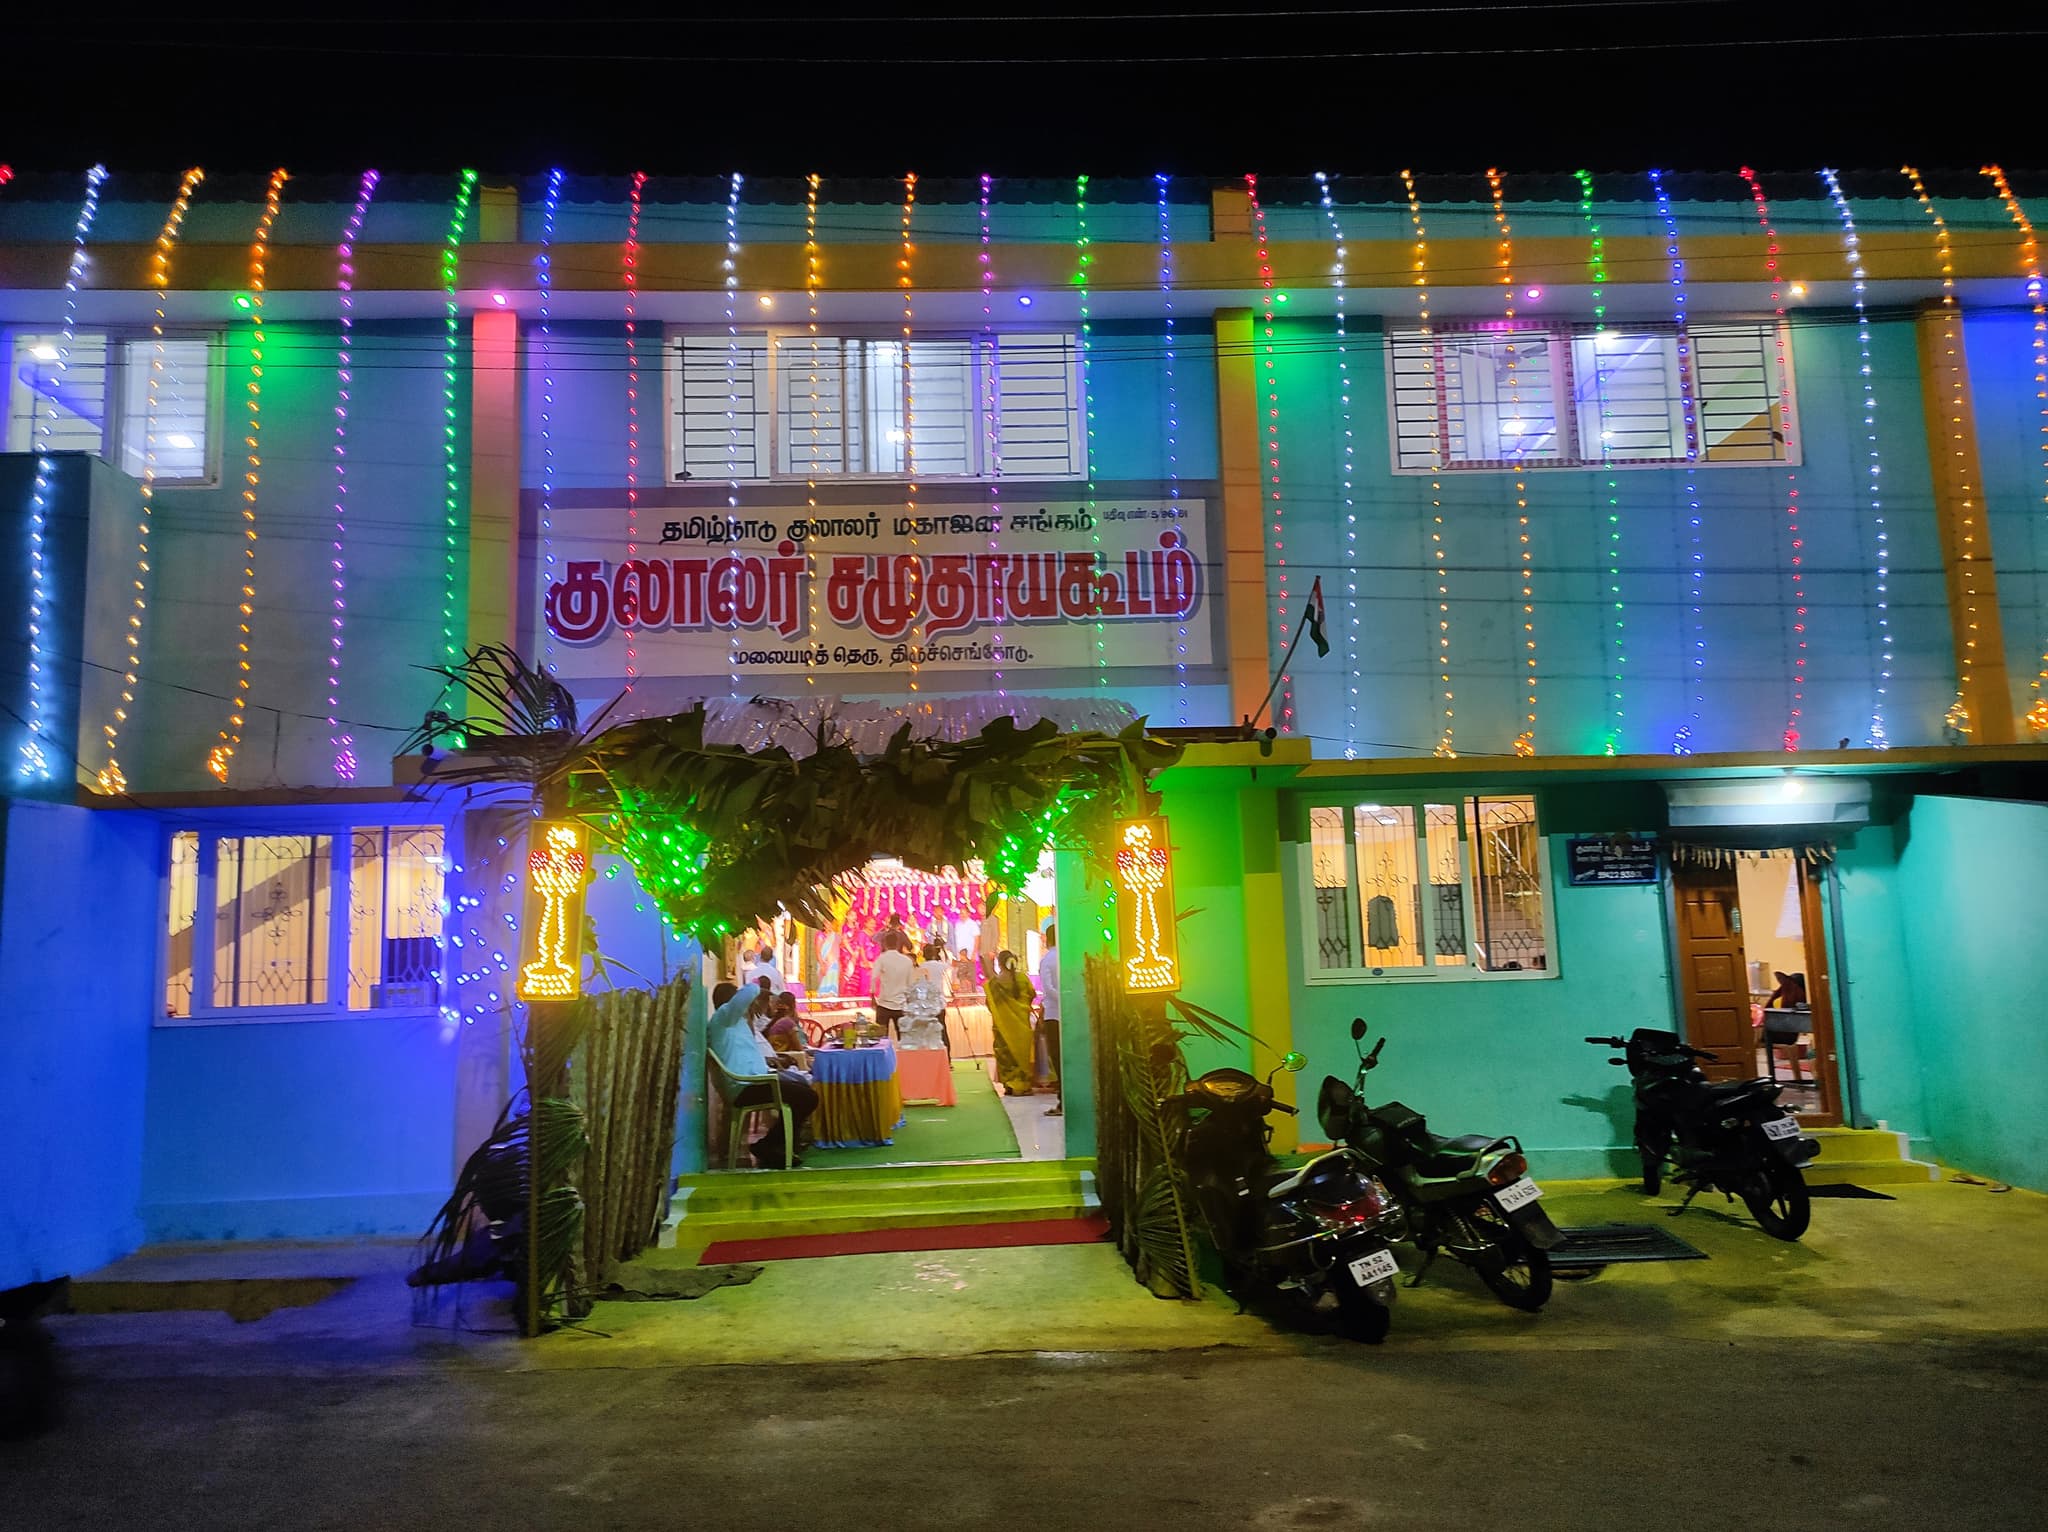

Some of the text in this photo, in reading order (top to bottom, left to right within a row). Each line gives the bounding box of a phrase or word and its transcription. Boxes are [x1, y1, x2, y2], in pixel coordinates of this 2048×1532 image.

[659, 508, 1093, 545] தமிழ்நாடு குலாலர் மகாஜன சங்கம்
[545, 531, 1197, 642] குலாலர் சமுதாயகூடம்
[1358, 1260, 1371, 1270] TN
